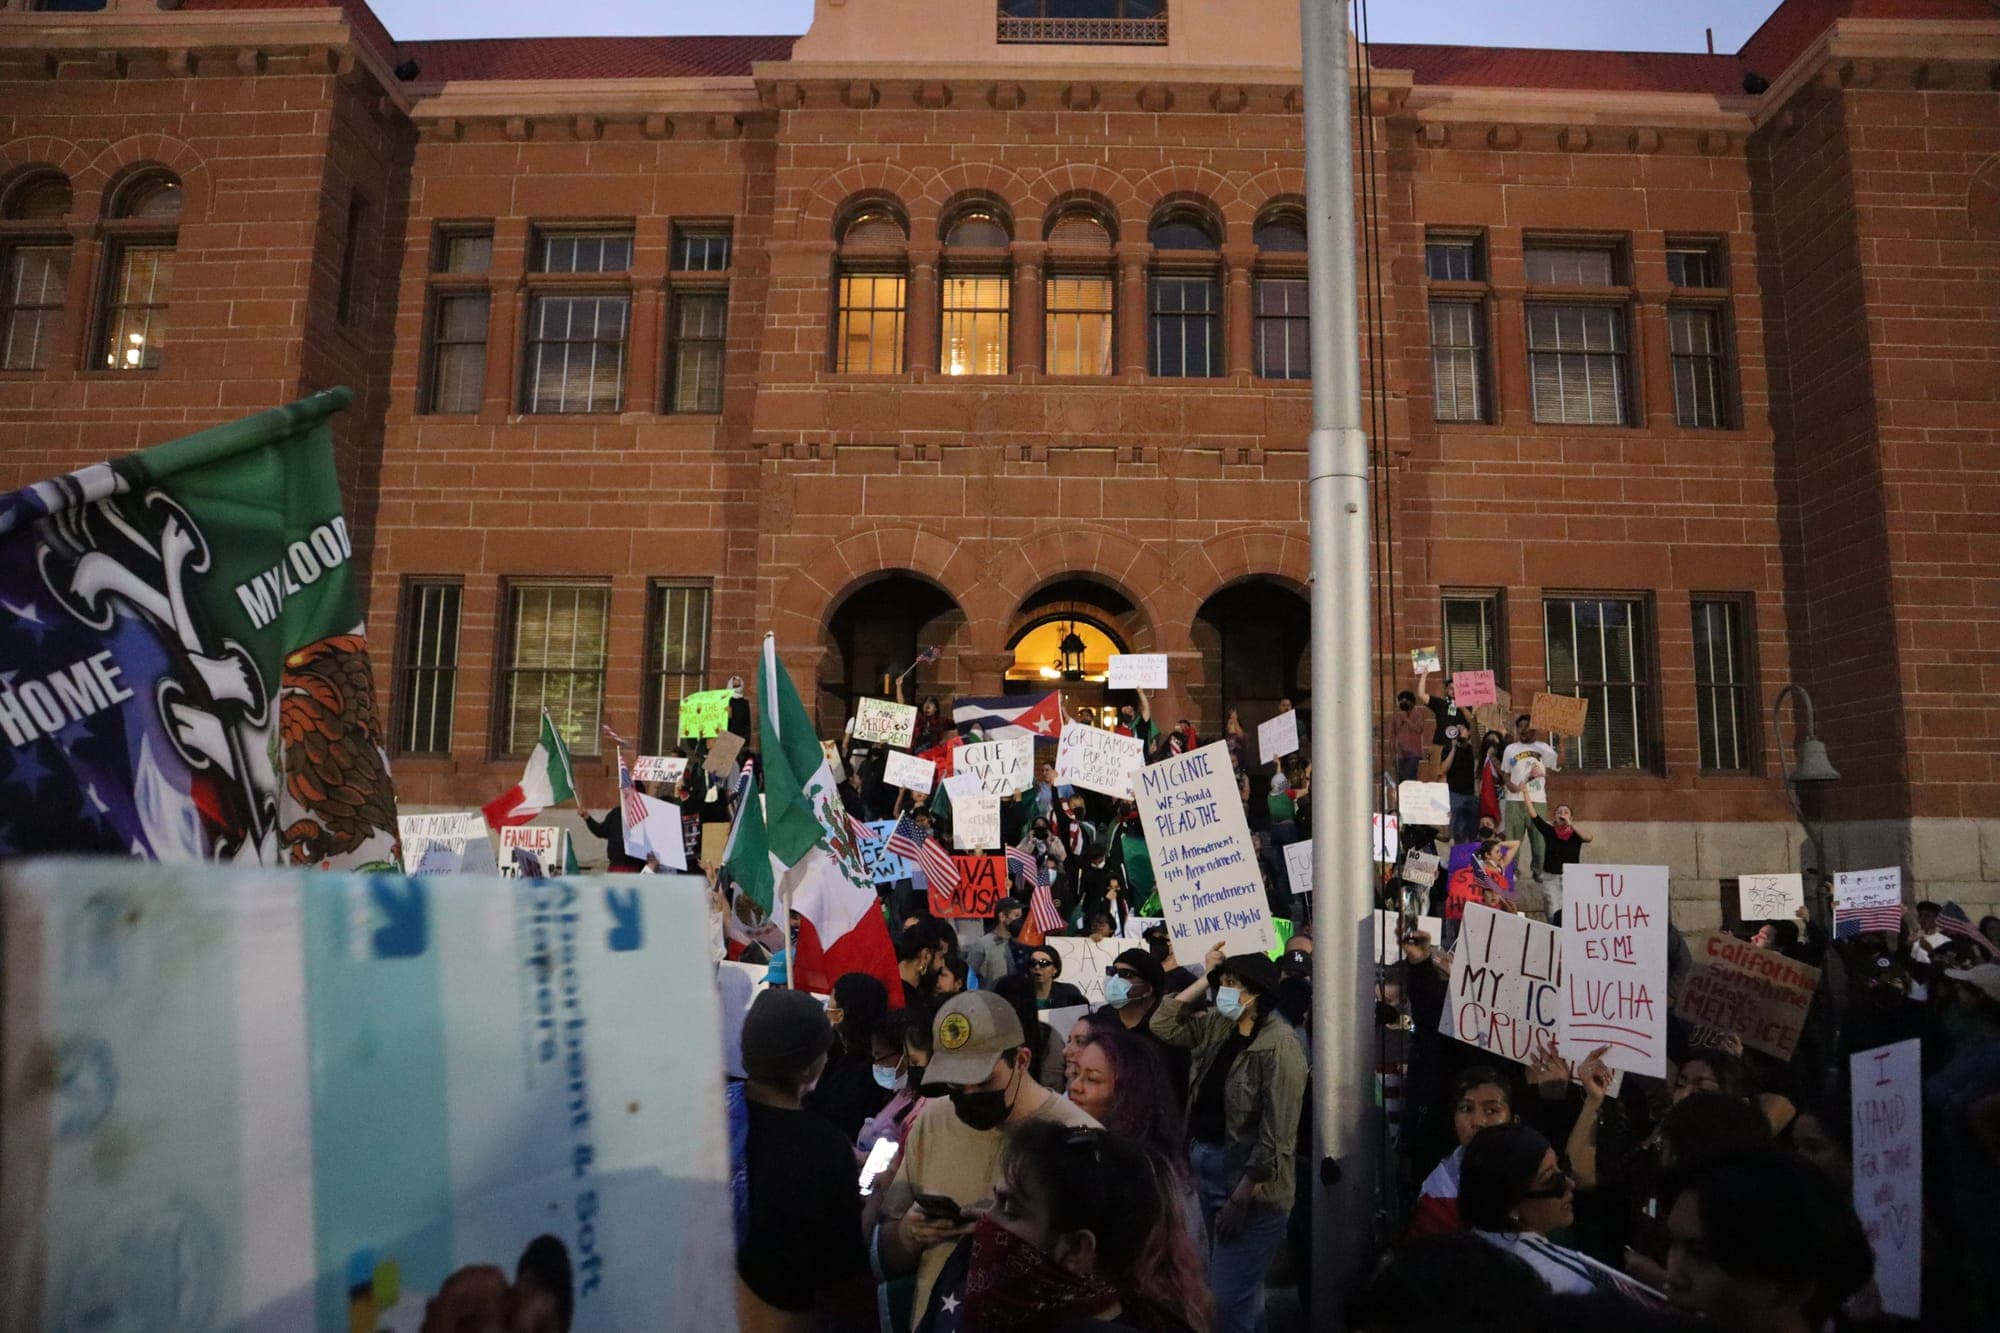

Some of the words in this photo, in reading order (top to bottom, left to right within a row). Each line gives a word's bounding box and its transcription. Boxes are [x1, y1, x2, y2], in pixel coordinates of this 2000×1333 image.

[235, 566, 283, 630] MY
[280, 516, 352, 596] LOOD
[0, 650, 134, 747] HOME
[964, 743, 1004, 765] QUE
[1068, 729, 1136, 756] GRITAMOS
[1001, 757, 1021, 775] LA
[981, 778, 1013, 795] AZA
[1156, 796, 1173, 811] WE
[1176, 788, 1212, 806] Should
[1196, 802, 1221, 827] THE
[504, 828, 554, 848] FAMILIES
[1160, 846, 1178, 867] 1st
[1286, 845, 1312, 875] FU
[956, 859, 997, 887] IVA
[1165, 866, 1183, 882] 4th
[1595, 874, 1623, 897] TU
[1173, 893, 1189, 912] 5th
[1192, 881, 1257, 912] Amendment
[1172, 922, 1191, 939] WE
[1194, 915, 1224, 935] HAVE
[1576, 902, 1650, 932] LUCHA
[1485, 913, 1496, 963] I
[1521, 923, 1562, 988] LI
[1586, 938, 1608, 960] ES
[1614, 936, 1633, 958] MI
[1461, 965, 1504, 1008] MY
[1526, 981, 1557, 1026] IC
[1570, 973, 1653, 1021] LUCHA
[1755, 1020, 1797, 1051] ICE
[576, 1189, 604, 1297] Soft
